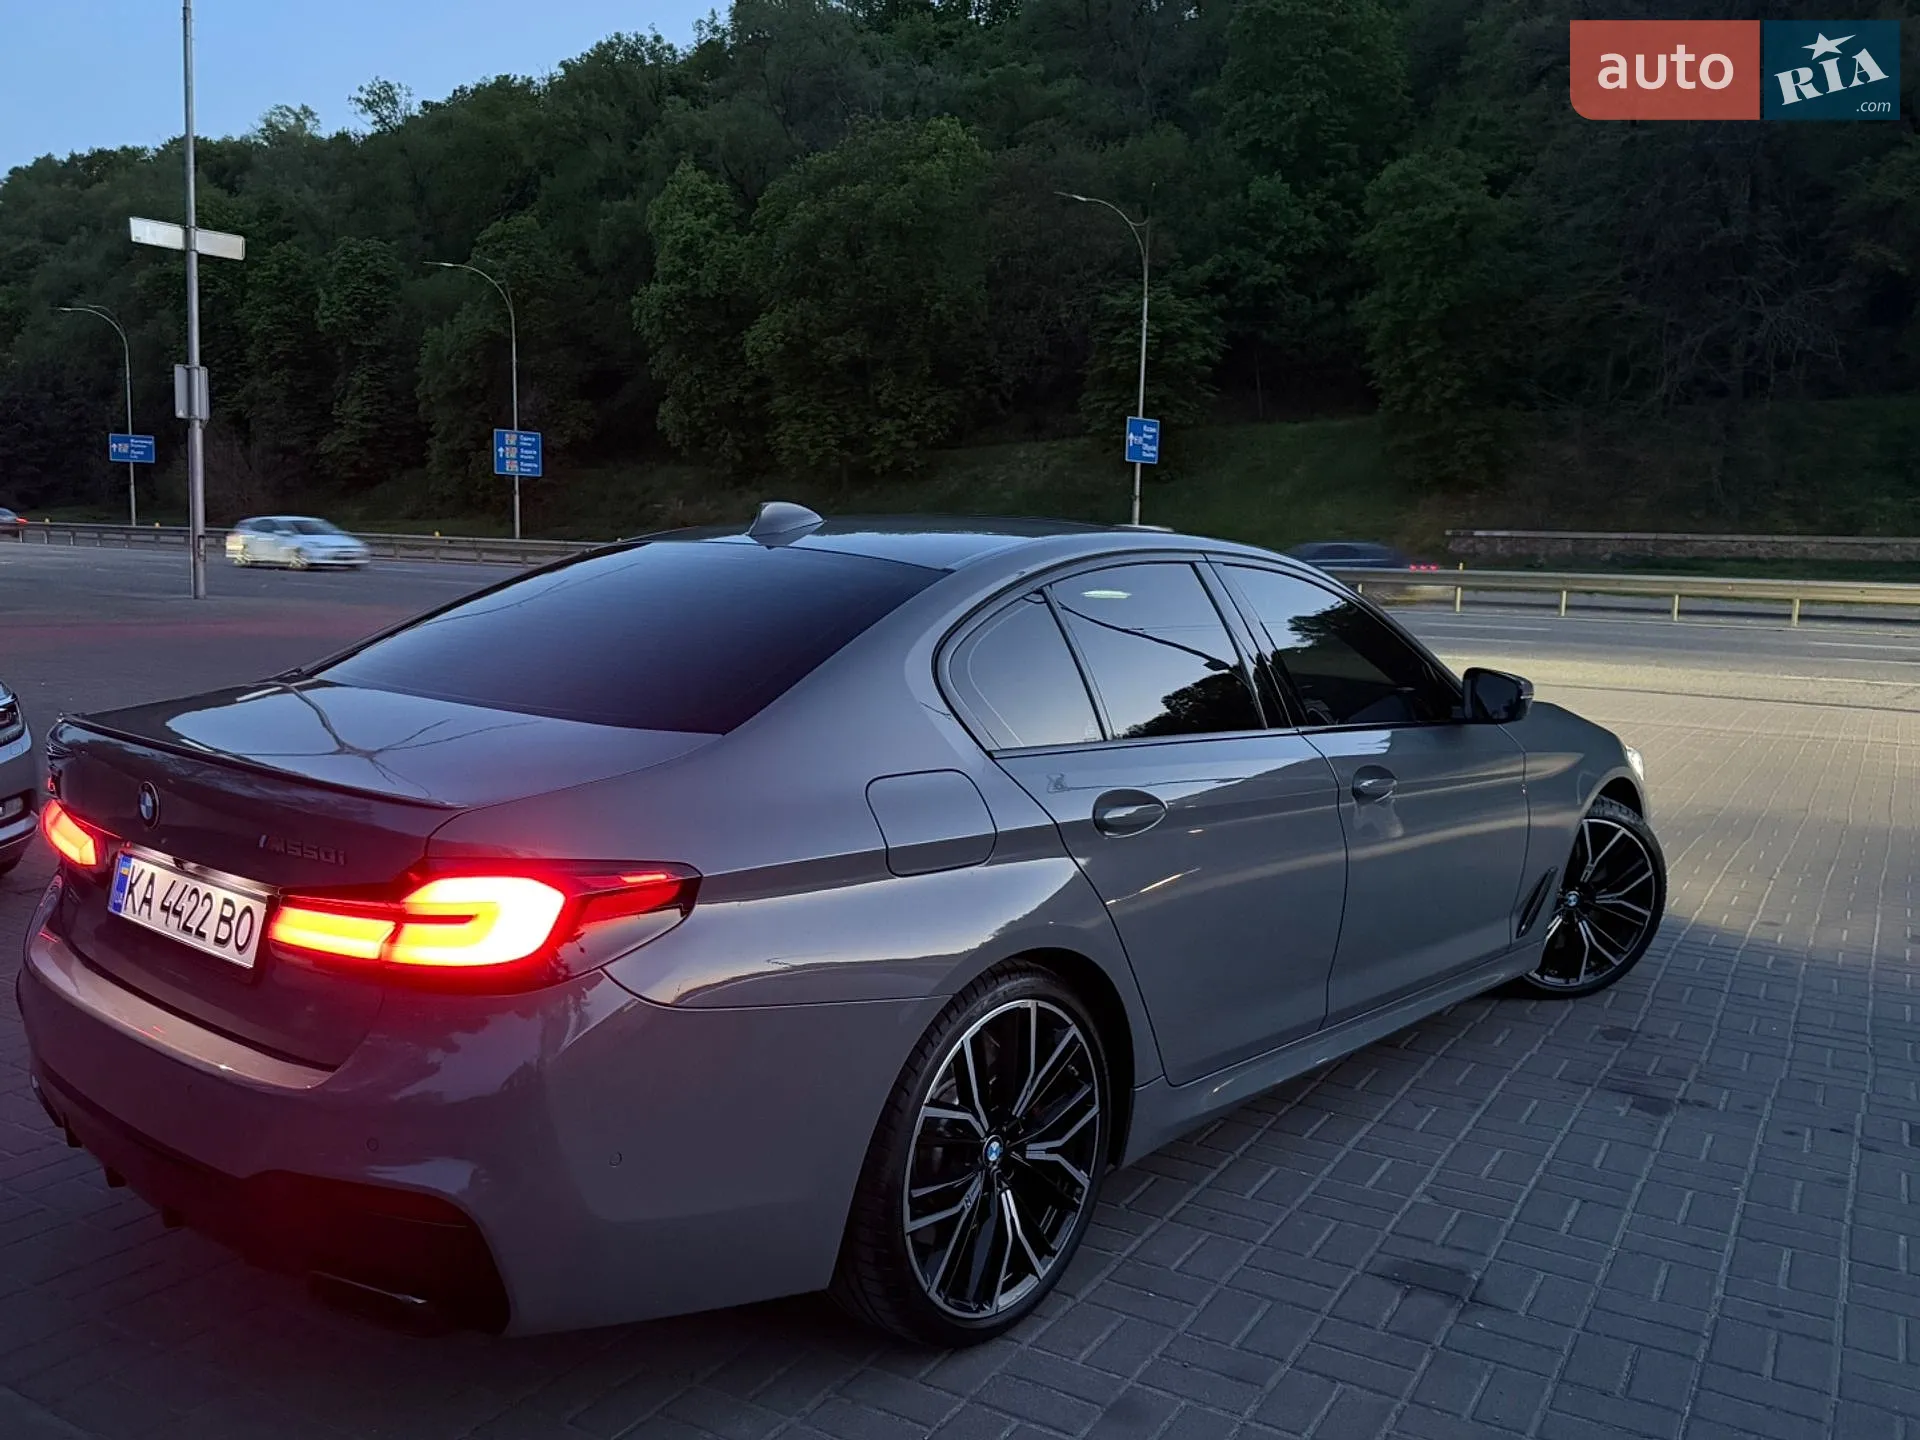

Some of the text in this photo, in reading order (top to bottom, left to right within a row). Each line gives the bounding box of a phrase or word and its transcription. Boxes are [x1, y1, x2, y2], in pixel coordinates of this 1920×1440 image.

[124, 863, 255, 955] KA 4422 BO
